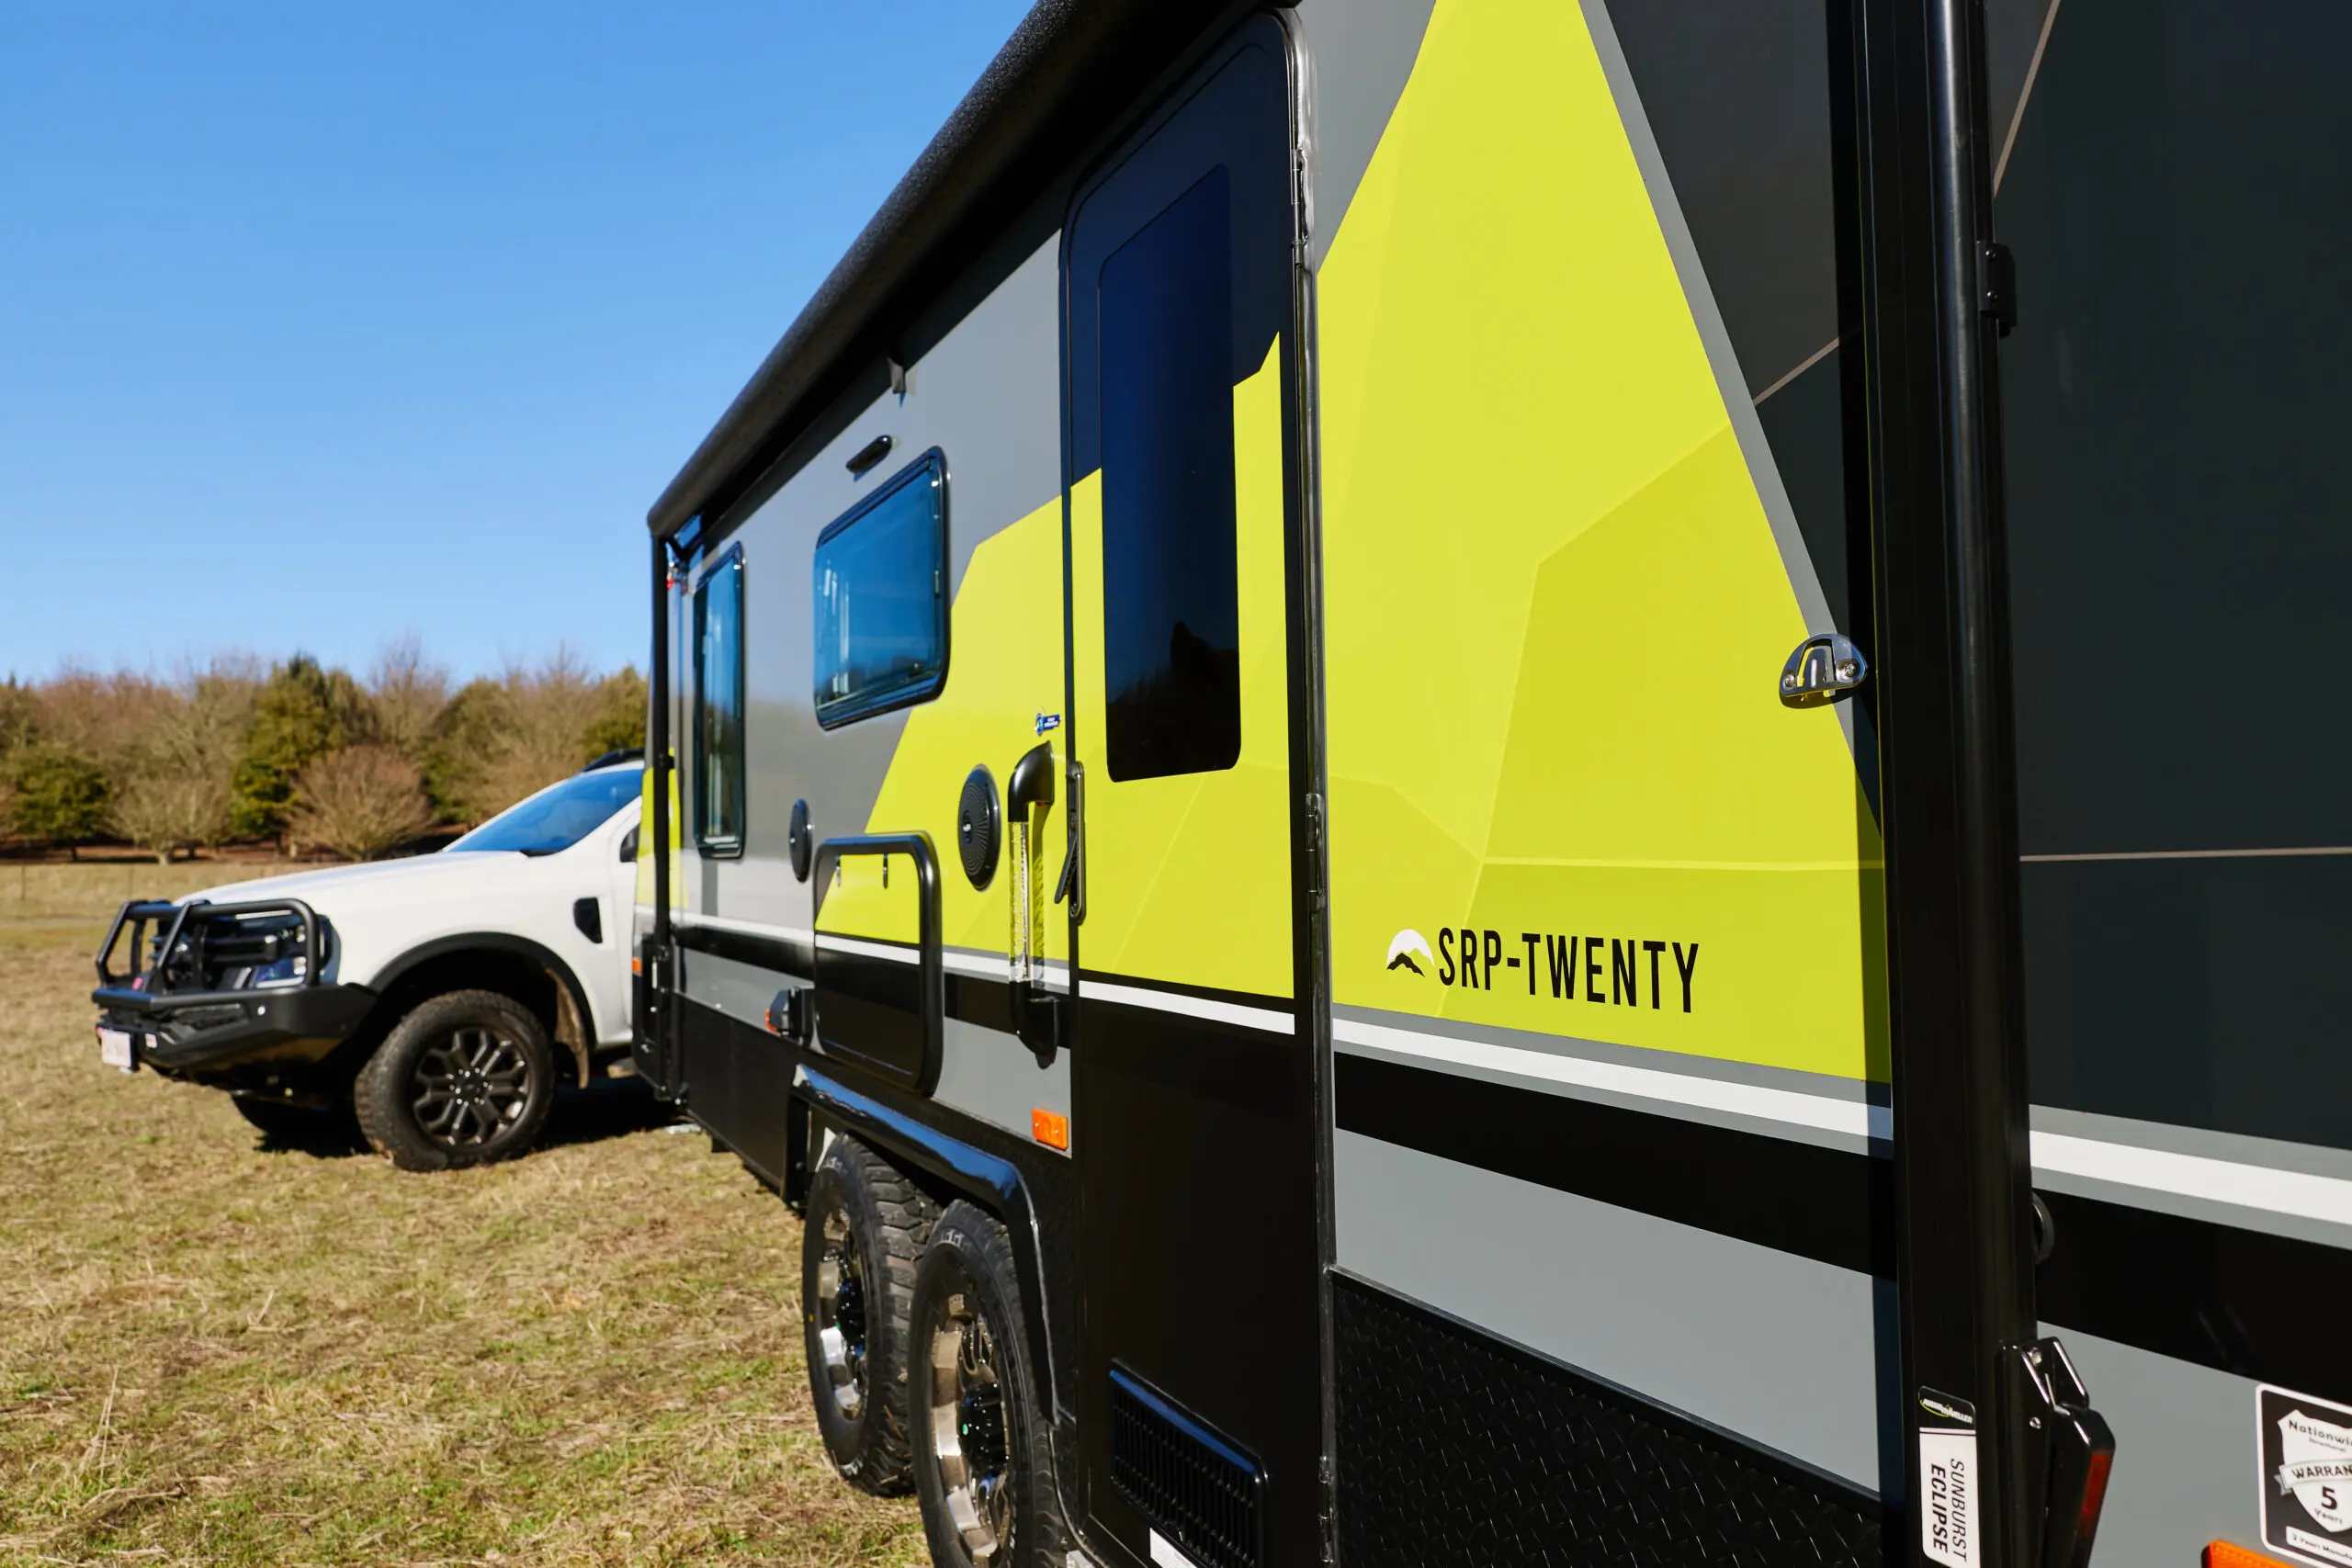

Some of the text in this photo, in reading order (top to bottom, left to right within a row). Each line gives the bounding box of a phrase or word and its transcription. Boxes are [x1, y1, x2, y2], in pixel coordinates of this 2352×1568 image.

[1439, 928, 1699, 1013] SRP-TWENTY
[2289, 1419, 2352, 1448] Nationwi
[1931, 1463, 1949, 1553] ECLIPSE
[1951, 1458, 1967, 1562] SUNBURST
[2321, 1485, 2338, 1510] 5
